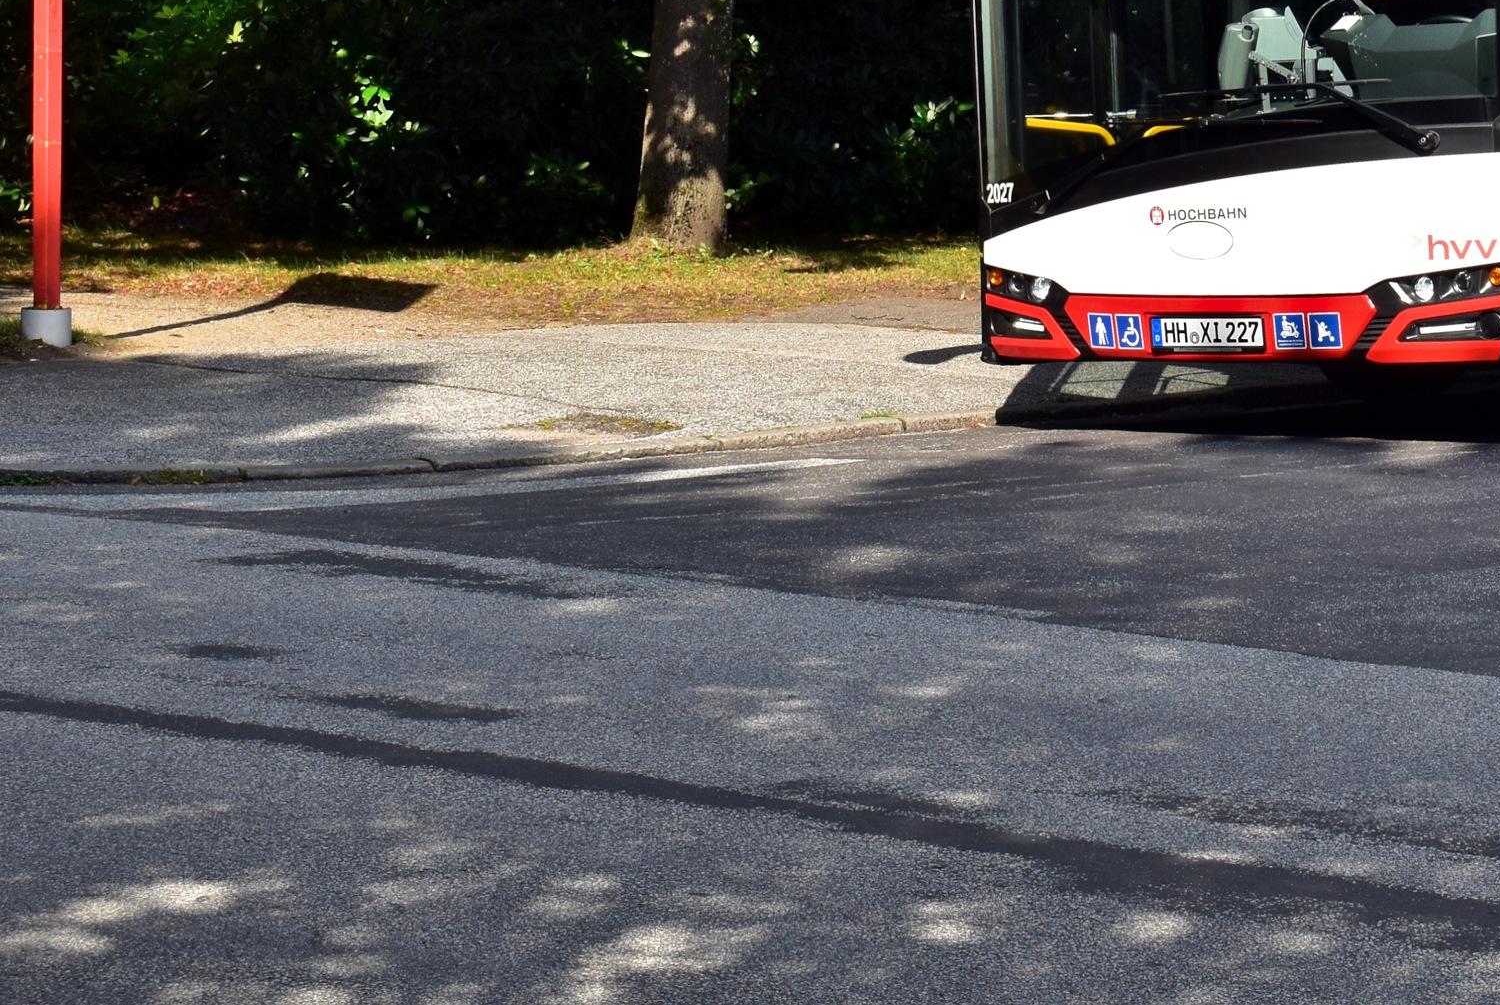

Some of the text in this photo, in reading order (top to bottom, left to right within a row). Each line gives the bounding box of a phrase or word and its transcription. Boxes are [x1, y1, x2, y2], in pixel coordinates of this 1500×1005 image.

[986, 182, 1014, 204] 2027
[1168, 207, 1247, 221] HOCHBAHN
[1428, 234, 1497, 260] hvv
[1164, 322, 1188, 343] HH
[1200, 322, 1222, 343] XI
[1225, 322, 1258, 343] 227
